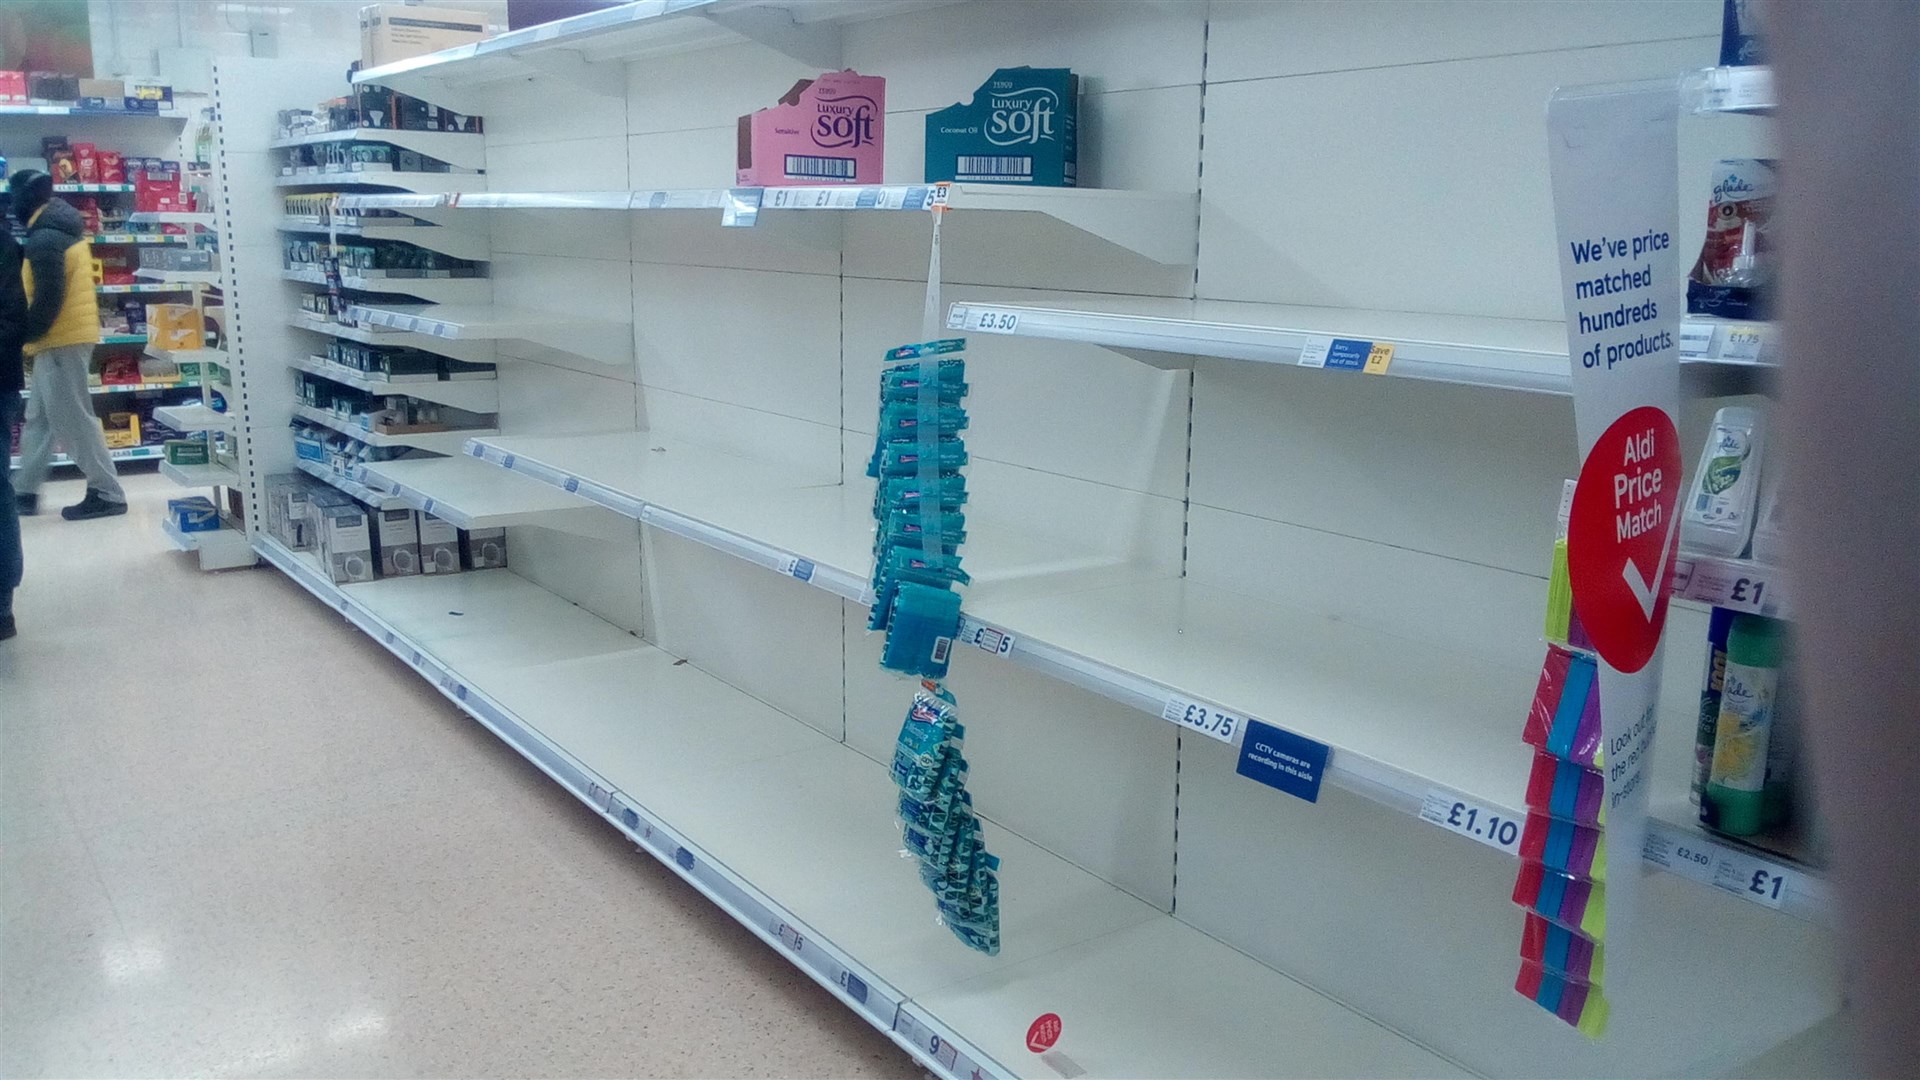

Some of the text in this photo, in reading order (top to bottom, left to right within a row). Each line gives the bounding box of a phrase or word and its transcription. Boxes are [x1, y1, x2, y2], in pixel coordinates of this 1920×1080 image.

[817, 103, 855, 117] Luxury
[991, 98, 1033, 111] Luxury
[817, 105, 874, 148] soft
[940, 126, 967, 134] Coconut
[991, 97, 1055, 144] soft
[775, 190, 788, 207] £1
[815, 190, 830, 207] £1
[937, 186, 947, 198] £3
[1713, 179, 1754, 203] glade
[1632, 229, 1670, 261] price
[1576, 264, 1652, 300] matched
[979, 312, 1017, 330] £3.50
[1579, 298, 1658, 335] hundreds
[1370, 345, 1390, 355] Save
[1582, 330, 1674, 371] of products.
[1728, 333, 1760, 344] £1.75
[1371, 355, 1383, 365] £2
[1623, 428, 1655, 467] Aldi
[1614, 467, 1662, 509] Price
[1616, 499, 1661, 544] Match
[1730, 577, 1765, 605] £1
[1183, 704, 1234, 737] £3.75
[1610, 726, 1632, 756] Look
[1248, 752, 1313, 782] recording in this aisle
[1255, 742, 1311, 769] CCTV cameras are
[1611, 760, 1627, 782] the
[1446, 801, 1518, 846] £1.10
[1677, 846, 1709, 866] £2.50
[1749, 869, 1784, 900] £1
